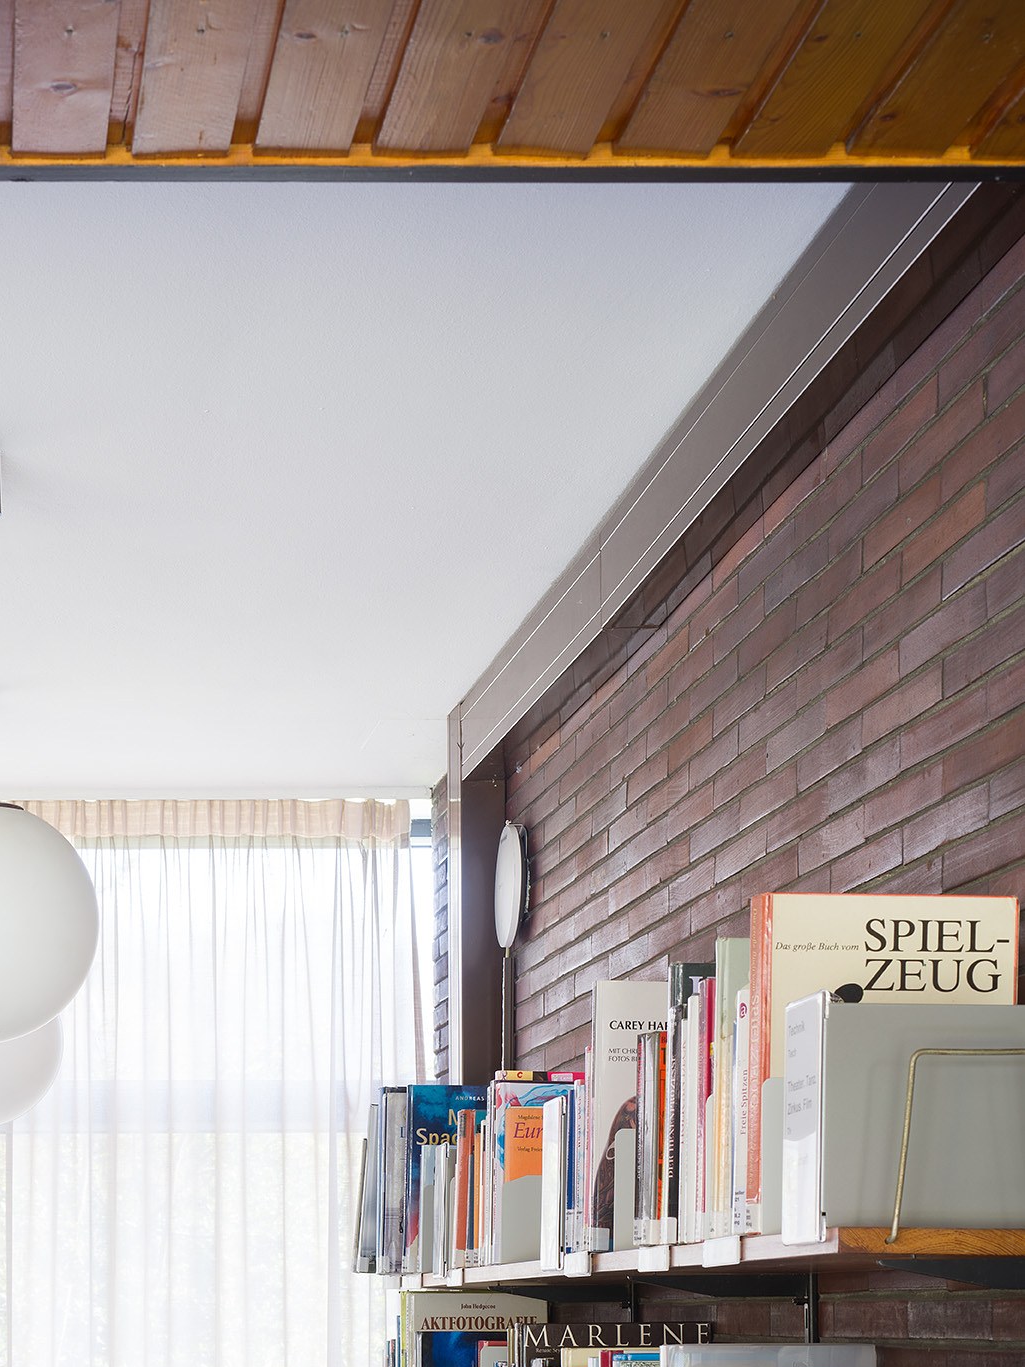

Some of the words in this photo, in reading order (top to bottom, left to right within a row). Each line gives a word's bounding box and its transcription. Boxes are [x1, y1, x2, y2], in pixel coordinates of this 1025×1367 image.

[775, 942, 792, 950] Das
[793, 942, 816, 952] große
[818, 943, 839, 951] Buch
[864, 918, 1010, 953] SPIEL-
[864, 958, 1002, 993] ZEUG
[609, 1020, 645, 1031] CAREY
[740, 1069, 748, 1108] Spitzen
[525, 1323, 711, 1348] MARLENE
